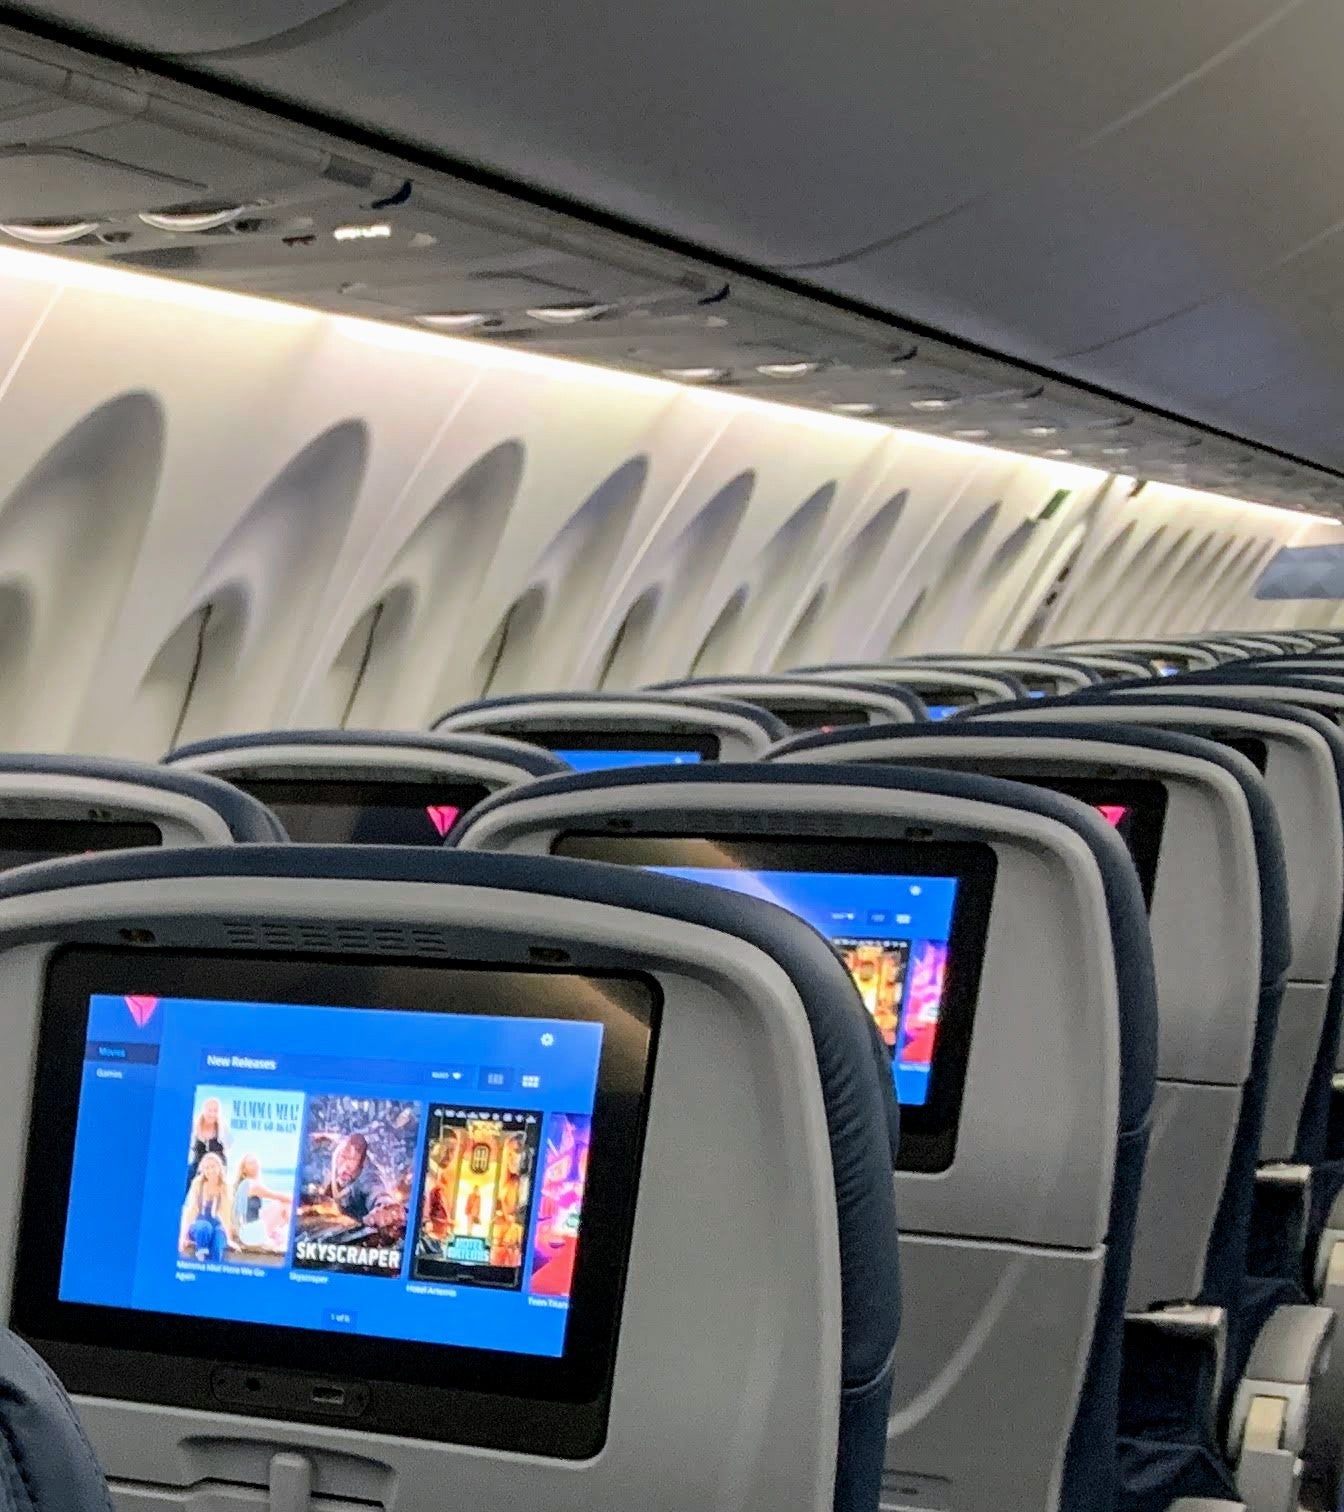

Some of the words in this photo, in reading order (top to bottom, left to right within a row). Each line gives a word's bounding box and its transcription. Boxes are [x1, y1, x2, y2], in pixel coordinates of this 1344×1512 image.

[207, 1055, 230, 1067] New
[231, 1057, 277, 1071] Releases
[296, 1242, 401, 1269] SKYSCRAPER
